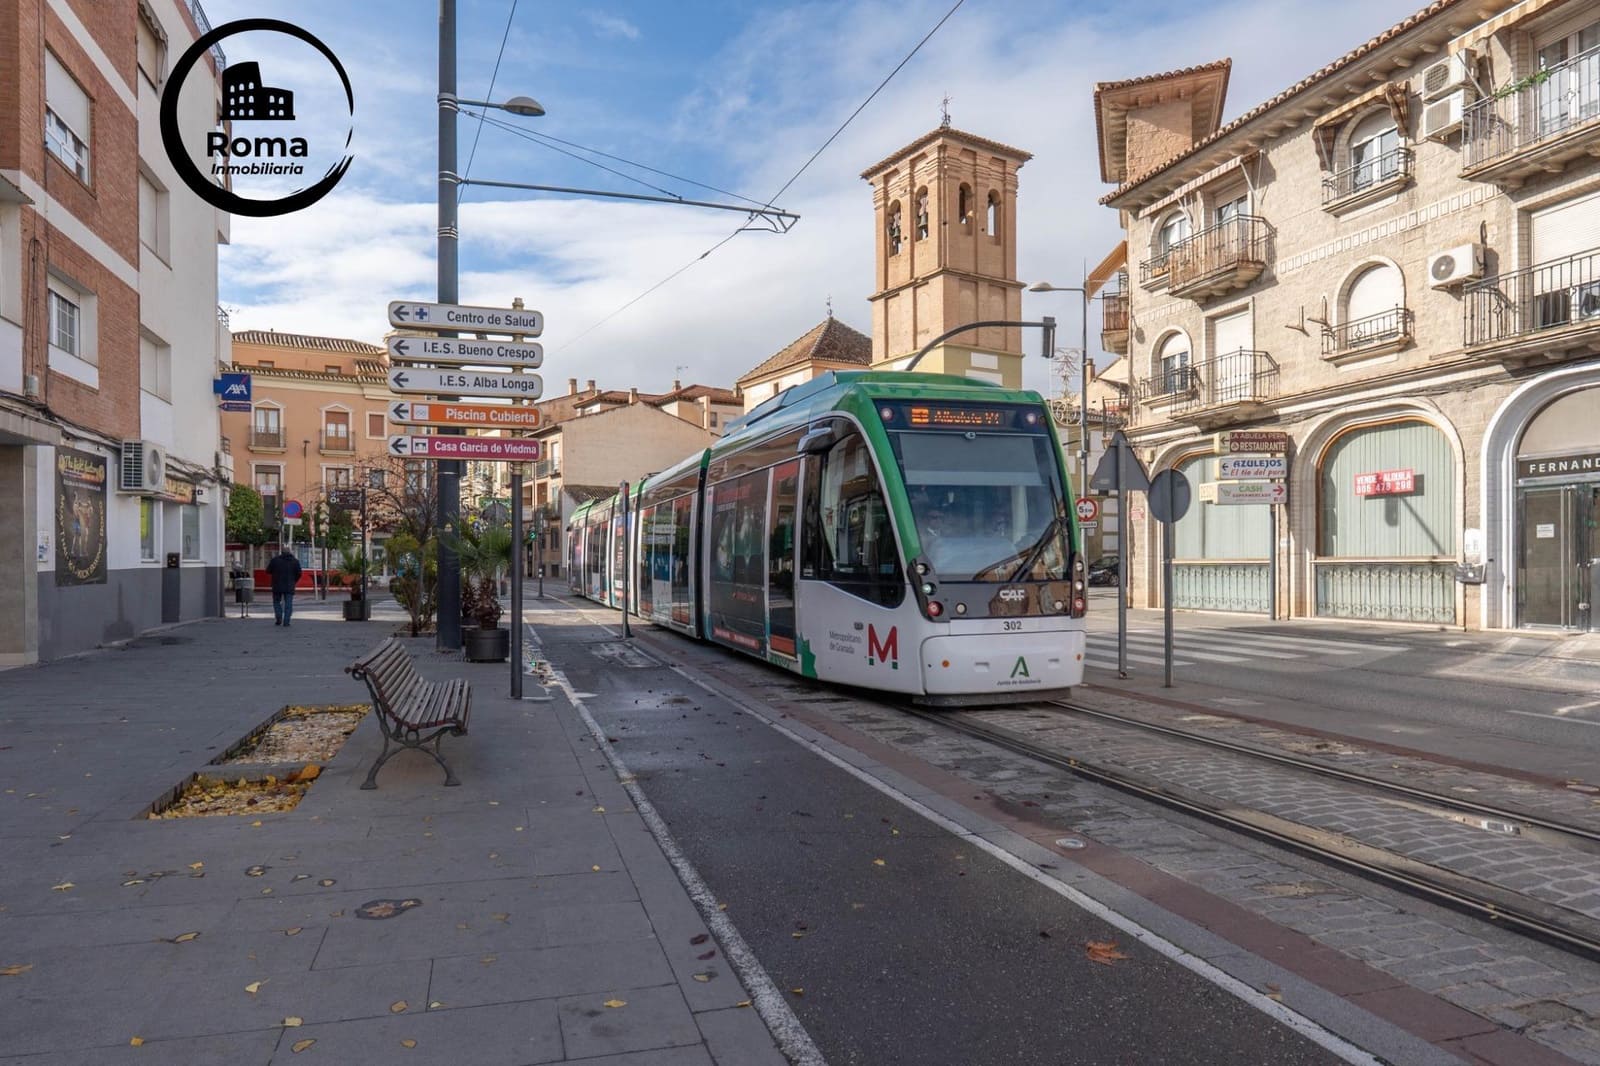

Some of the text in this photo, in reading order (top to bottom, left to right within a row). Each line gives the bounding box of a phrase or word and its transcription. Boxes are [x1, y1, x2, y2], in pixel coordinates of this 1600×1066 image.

[447, 310, 536, 328] Centro de Salud
[423, 341, 536, 360] I.E.S. Bueno Crespo
[225, 383, 248, 395] AXA
[439, 375, 535, 392] I.E.S. Alba Longa
[446, 407, 536, 423] Piscina Cubierta
[434, 440, 457, 452] Casa
[491, 442, 502, 453] de
[504, 443, 537, 455] Viedma
[1239, 441, 1286, 451] RESTAURANTE
[1233, 459, 1283, 469] AZULEJOS
[1254, 468, 1265, 476] del
[1382, 471, 1412, 482] ALQUILA
[1238, 485, 1263, 493] CASH
[999, 589, 1025, 601] CAF
[1003, 620, 1023, 631] 302
